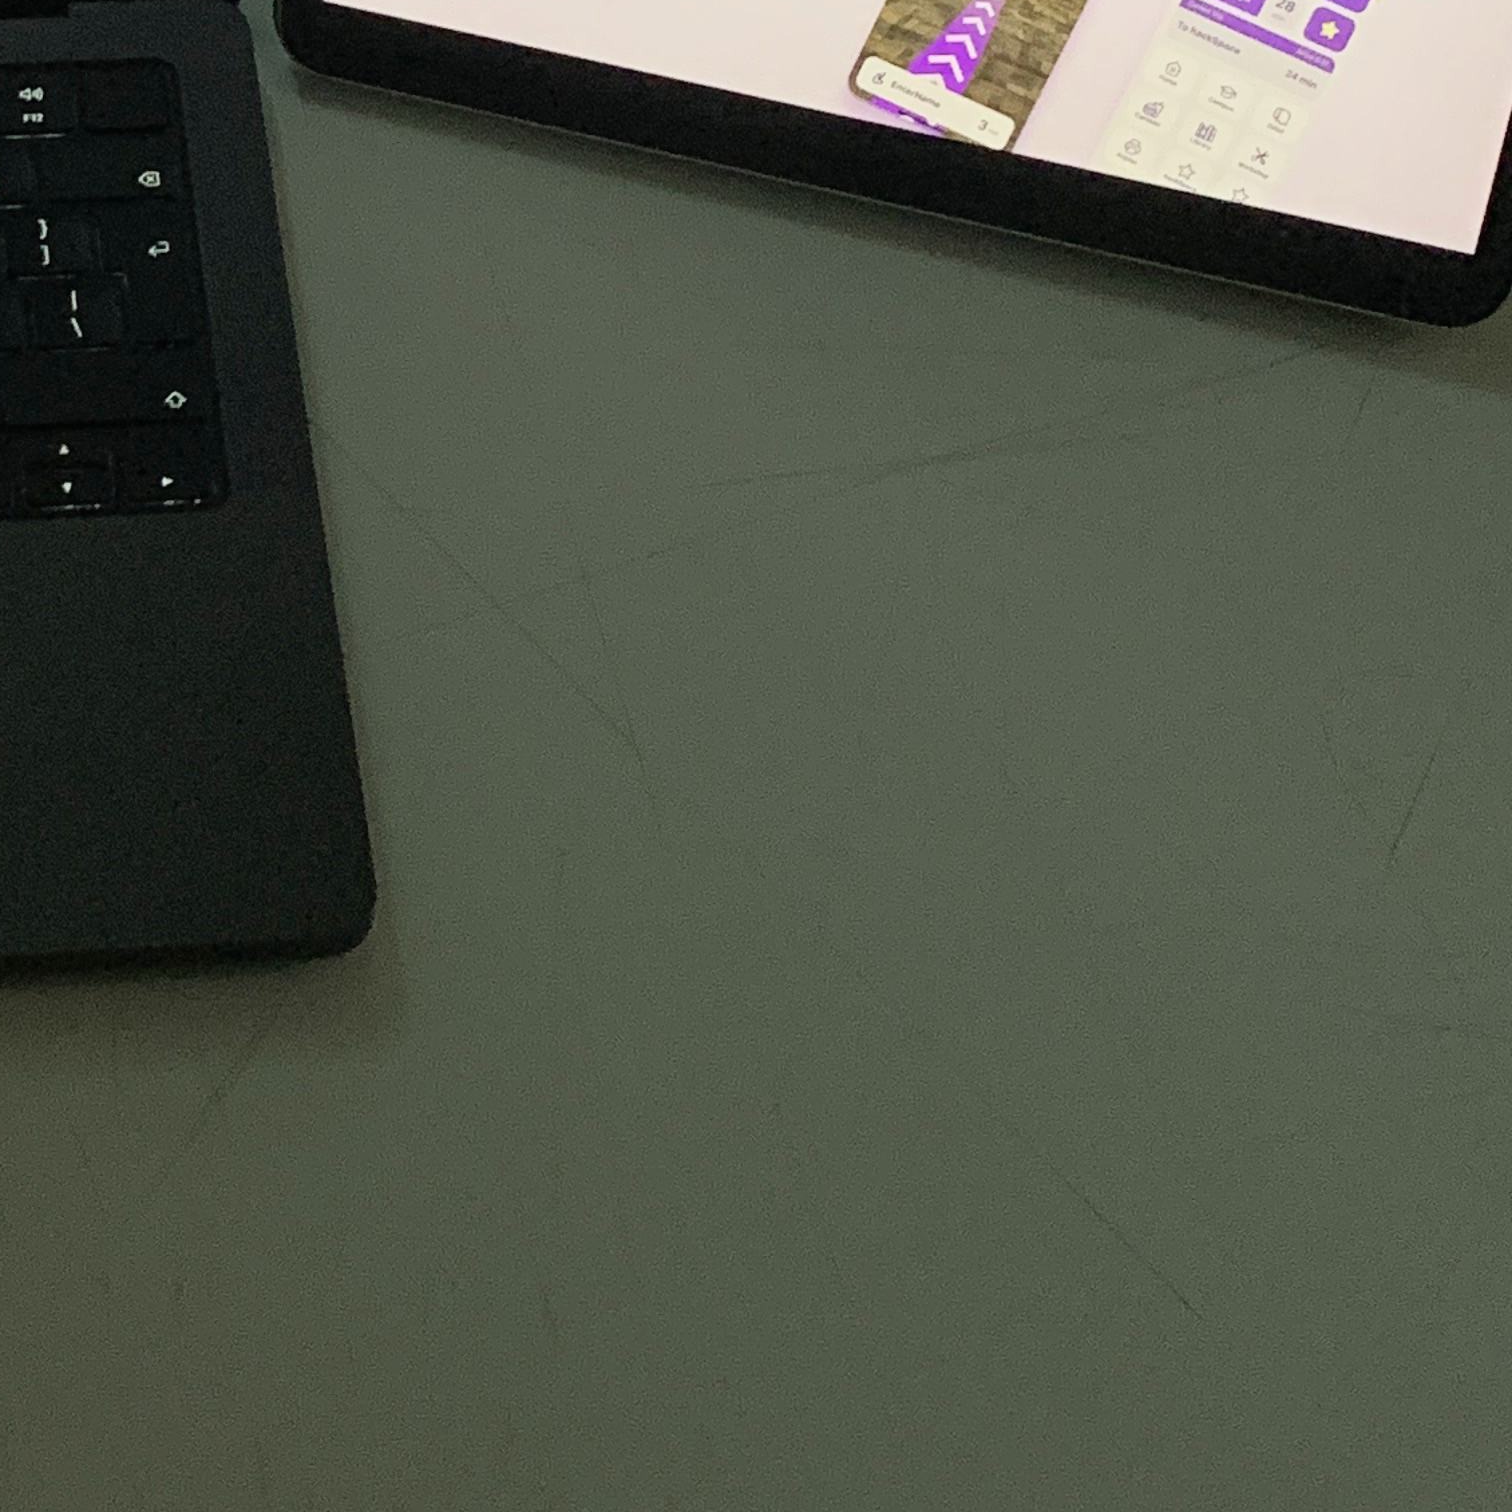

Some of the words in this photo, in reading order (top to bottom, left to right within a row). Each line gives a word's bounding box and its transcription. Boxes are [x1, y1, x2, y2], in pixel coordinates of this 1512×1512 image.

[1178, 19, 1190, 32] To
[1284, 68, 1299, 81] 24
[1298, 76, 1318, 90] min
[22, 112, 44, 123] F12
[977, 118, 989, 131] 3
